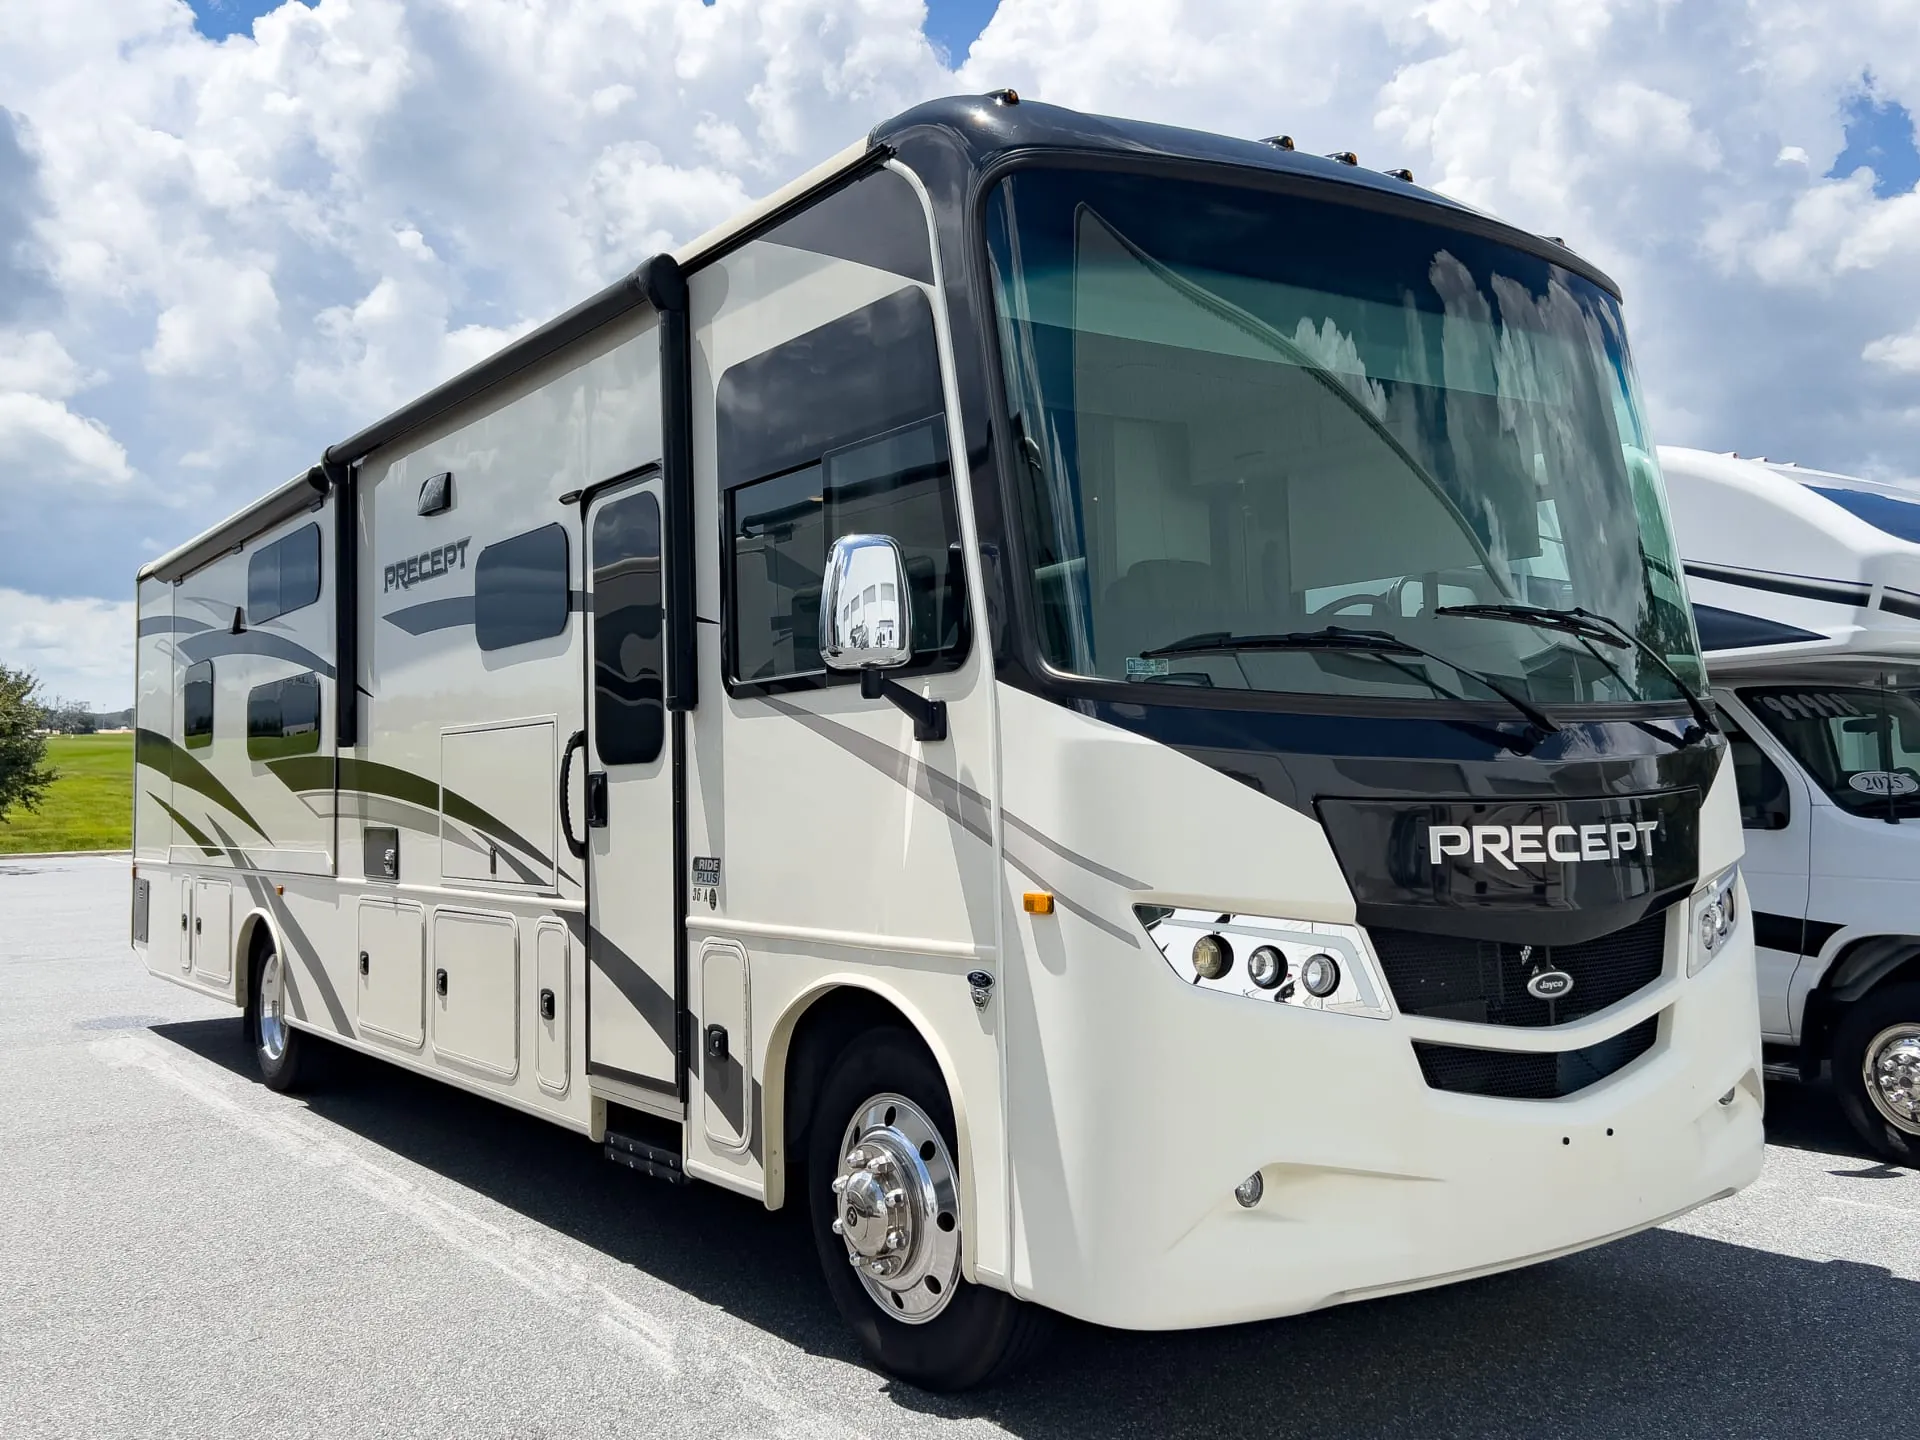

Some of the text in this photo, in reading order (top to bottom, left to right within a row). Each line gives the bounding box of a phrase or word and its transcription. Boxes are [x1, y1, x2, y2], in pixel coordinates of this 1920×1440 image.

[384, 536, 472, 594] PRECEPT
[1861, 776, 1904, 790] 2025
[1428, 820, 1659, 871] PRECEPT
[697, 872, 718, 884] PLUS
[692, 887, 702, 902] 36
[703, 888, 708, 903] A
[1539, 980, 1564, 990] Jayco
